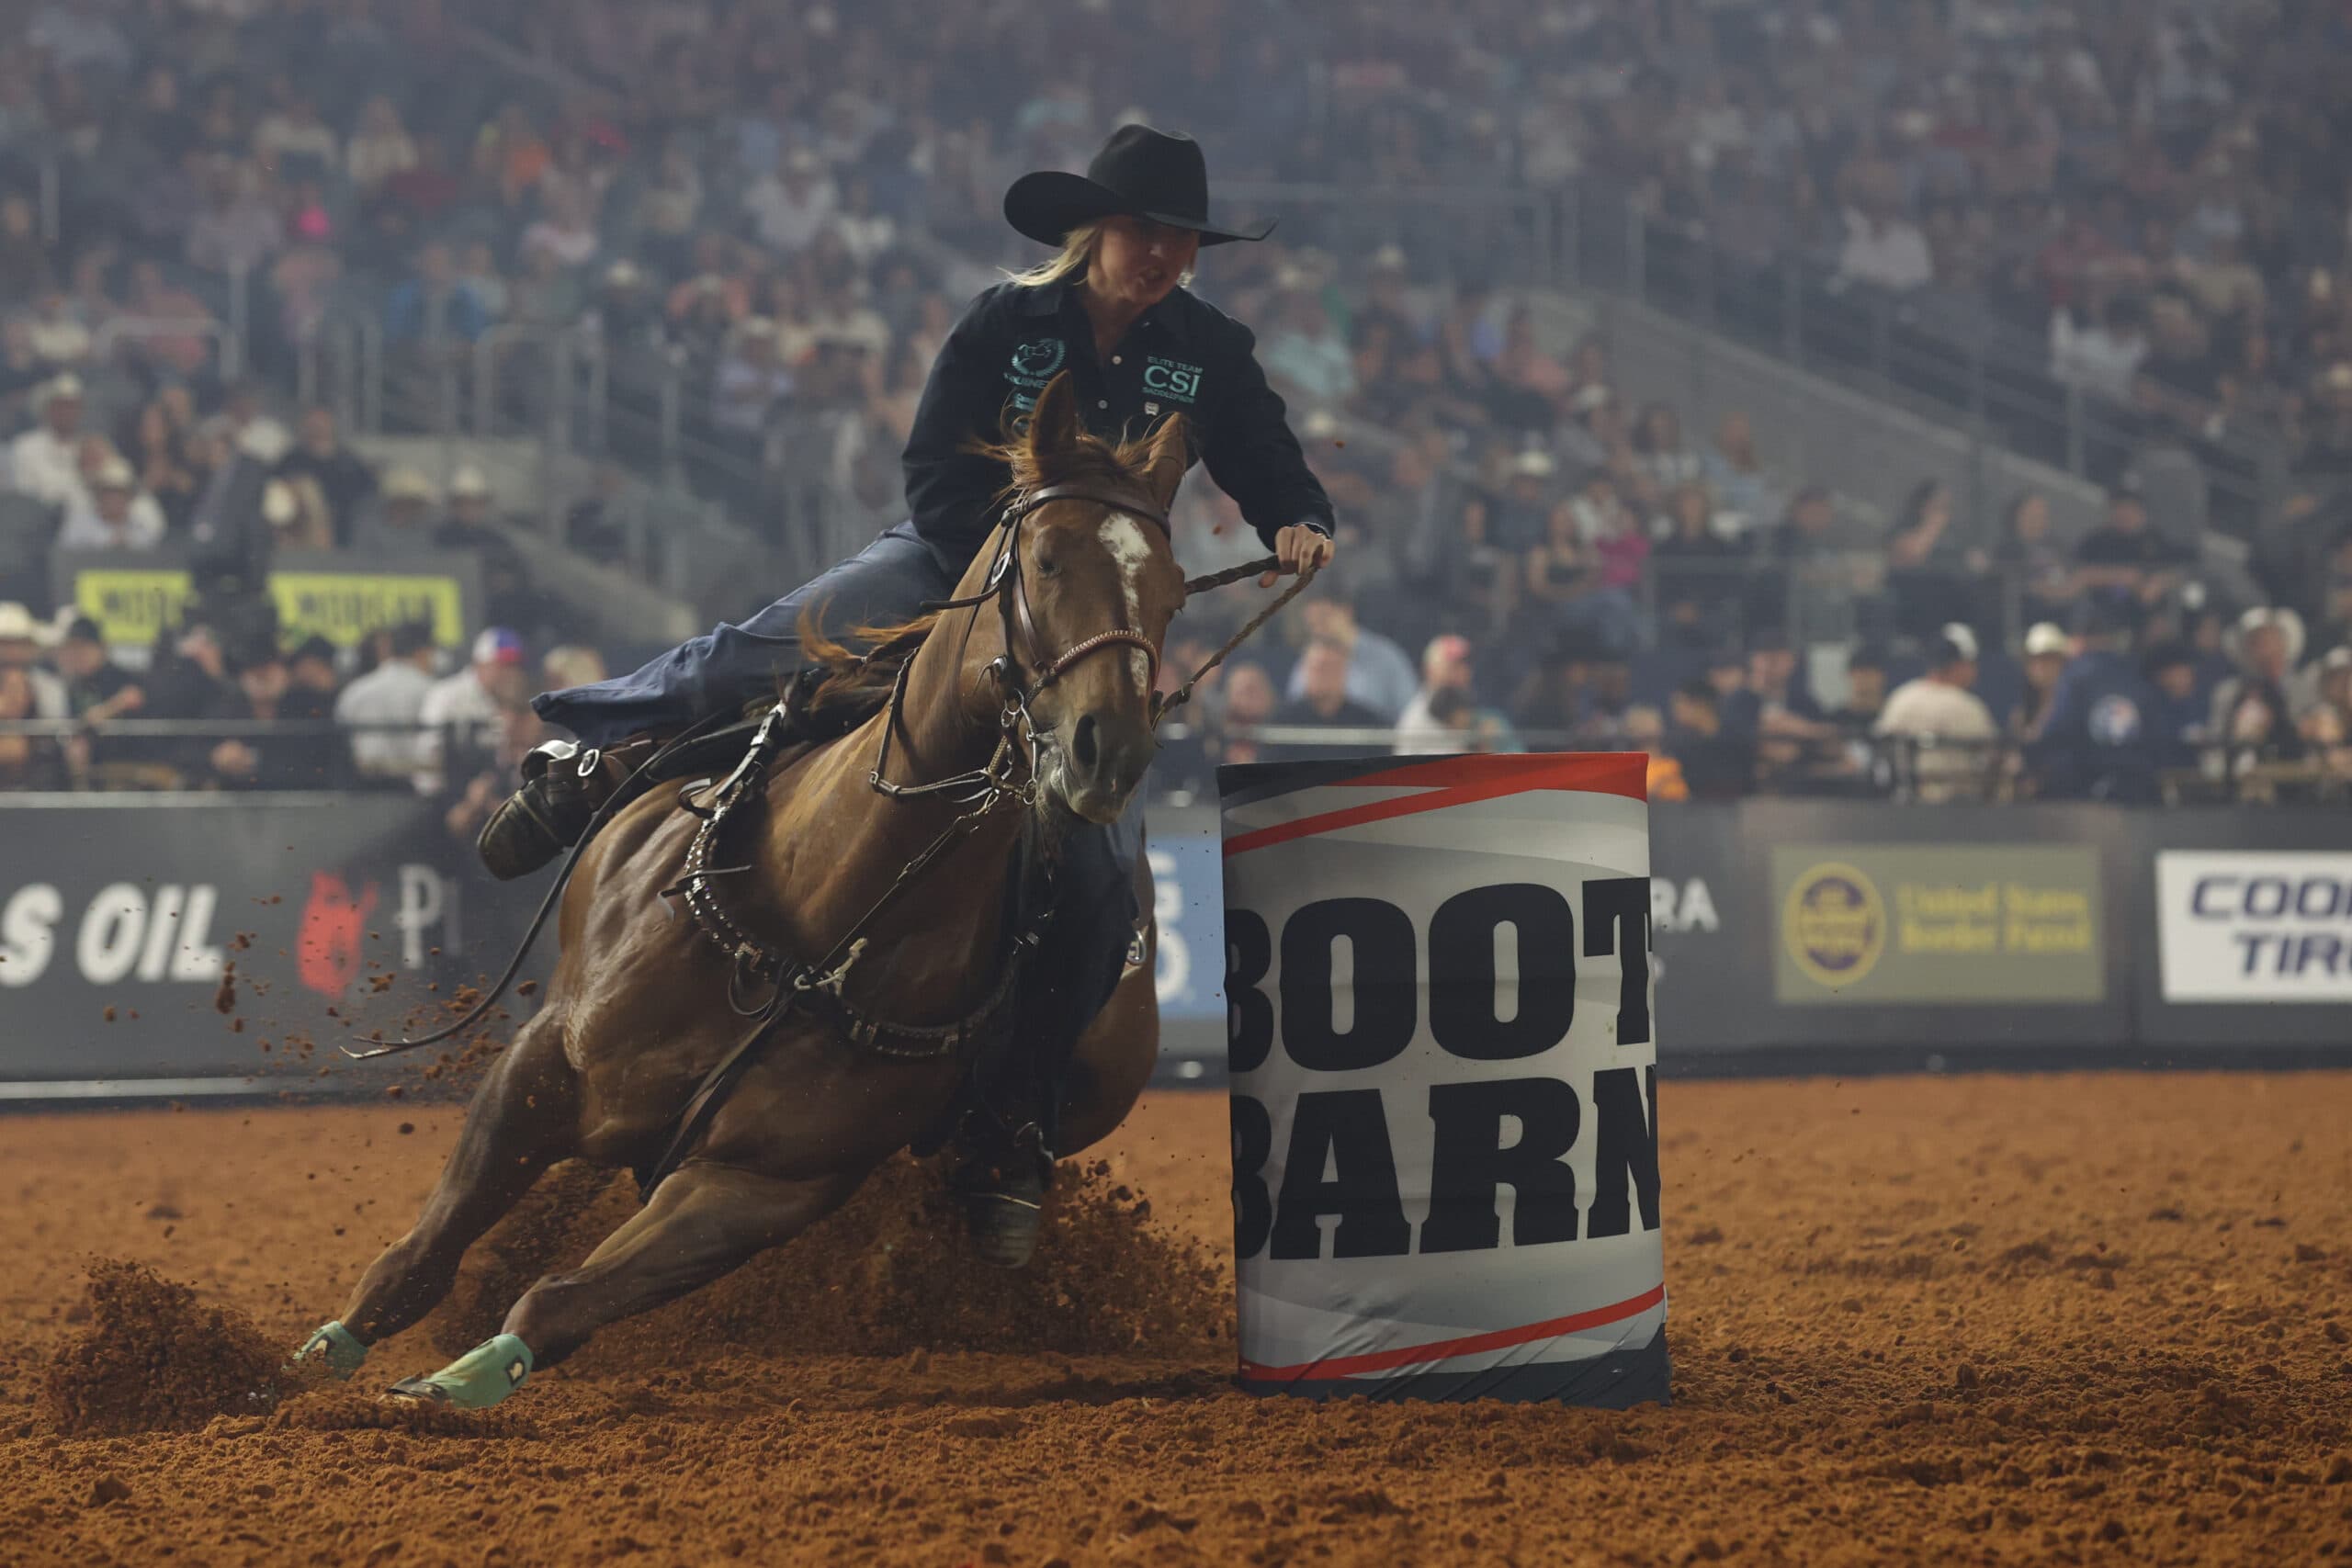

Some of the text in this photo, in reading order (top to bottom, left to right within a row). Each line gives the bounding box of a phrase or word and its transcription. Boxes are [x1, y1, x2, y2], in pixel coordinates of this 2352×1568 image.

[1143, 365, 1202, 397] CSI
[1177, 361, 1204, 375] TEAM
[2190, 874, 2352, 921] COO
[76, 881, 226, 986] OIL
[2233, 932, 2352, 977] TIR
[1225, 877, 1654, 1073] BOOT
[1231, 1064, 1661, 1260] BARN
